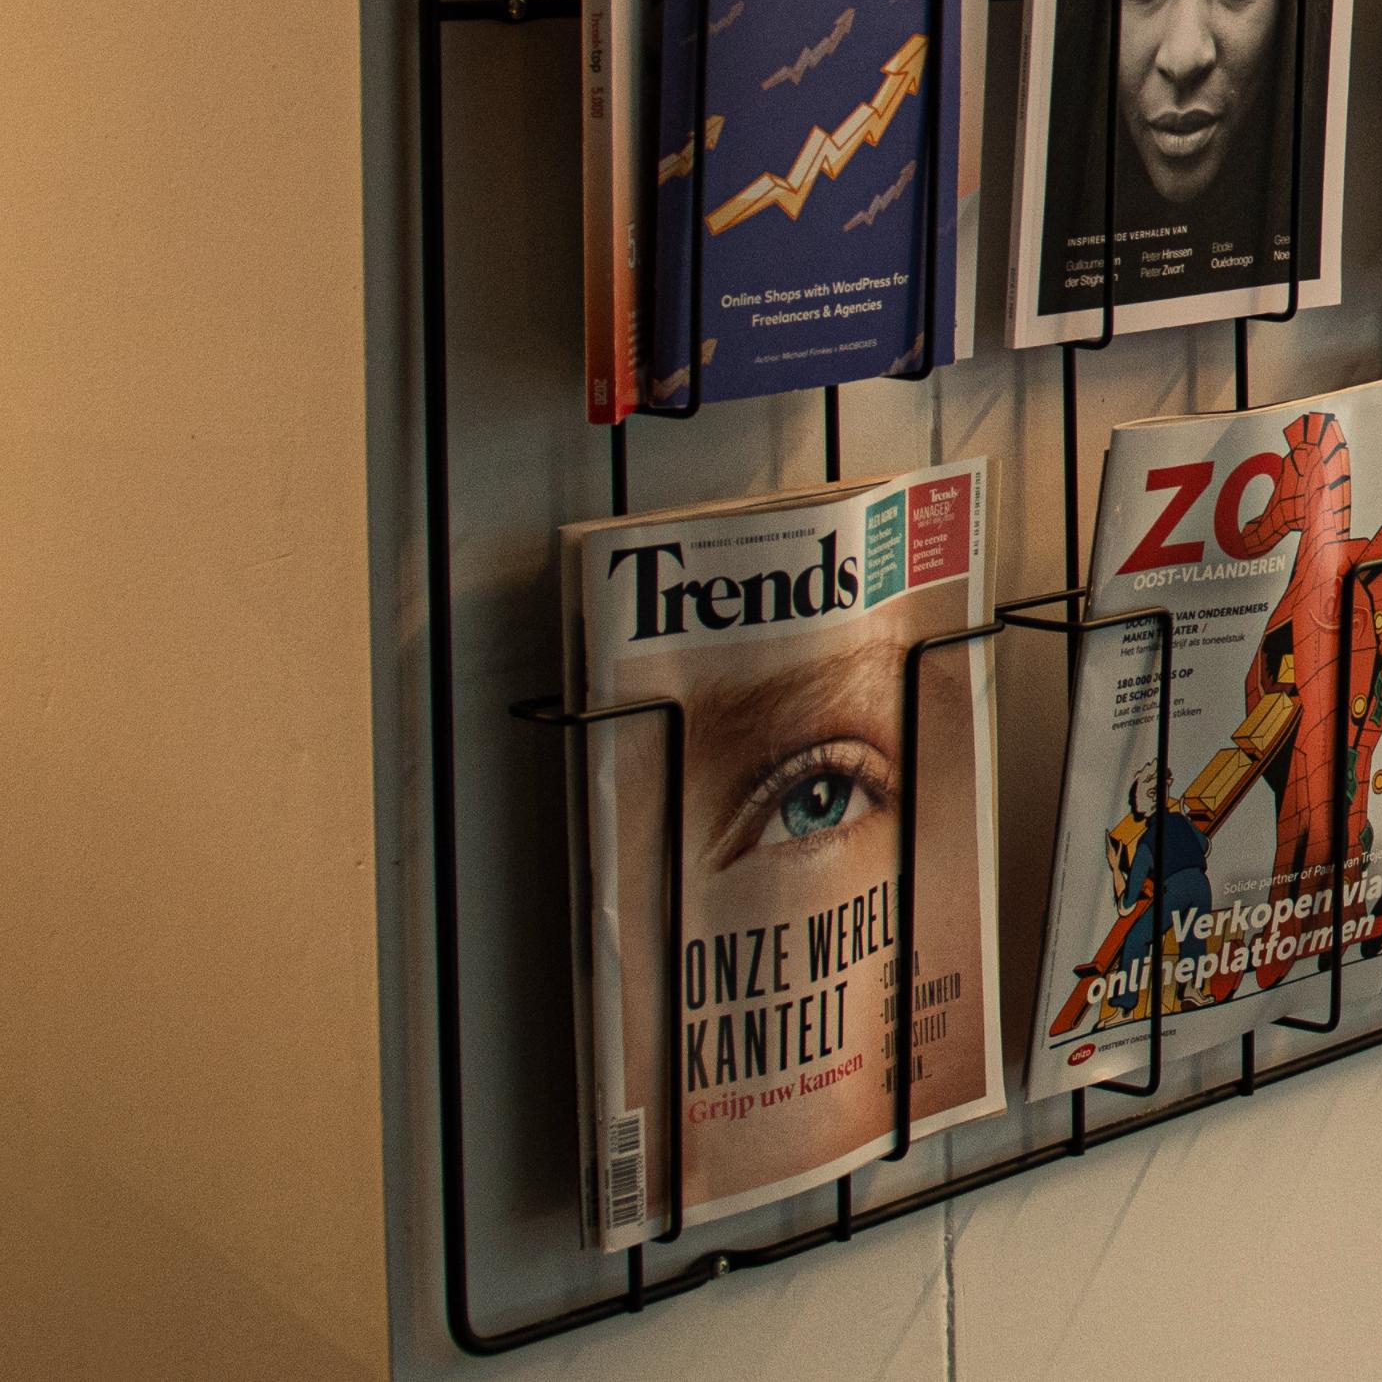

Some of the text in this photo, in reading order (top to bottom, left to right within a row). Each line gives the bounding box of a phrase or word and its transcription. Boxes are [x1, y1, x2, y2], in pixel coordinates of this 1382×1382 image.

[1130, 225, 1188, 241] VERHALEN VAN
[1162, 247, 1193, 260] Hinssen
[1162, 263, 1185, 276] Zwart
[721, 272, 910, 309] Online Shops with WordPress for
[752, 299, 883, 327] Freelancers & Agencies
[924, 533, 948, 546] eerste
[1133, 555, 1287, 591] OOST-VLAANDEREN
[607, 529, 859, 642] Trends
[1176, 602, 1269, 621] VAN ONDERNEMERS
[1122, 629, 1154, 644] MAKEN
[1202, 632, 1246, 647] toneelstuk
[1178, 668, 1194, 680] OP
[1115, 686, 1161, 705] DE SCHOP
[1223, 879, 1258, 897] Solide
[1258, 870, 1299, 892] partner
[1300, 866, 1314, 881] of
[1170, 884, 1334, 945] Verkopen
[685, 881, 895, 1011] ONZE WEREL
[685, 981, 849, 1093] KANTELT
[687, 1091, 755, 1125] Grijp
[760, 1081, 796, 1107] uw
[800, 1052, 864, 1097] kansen
